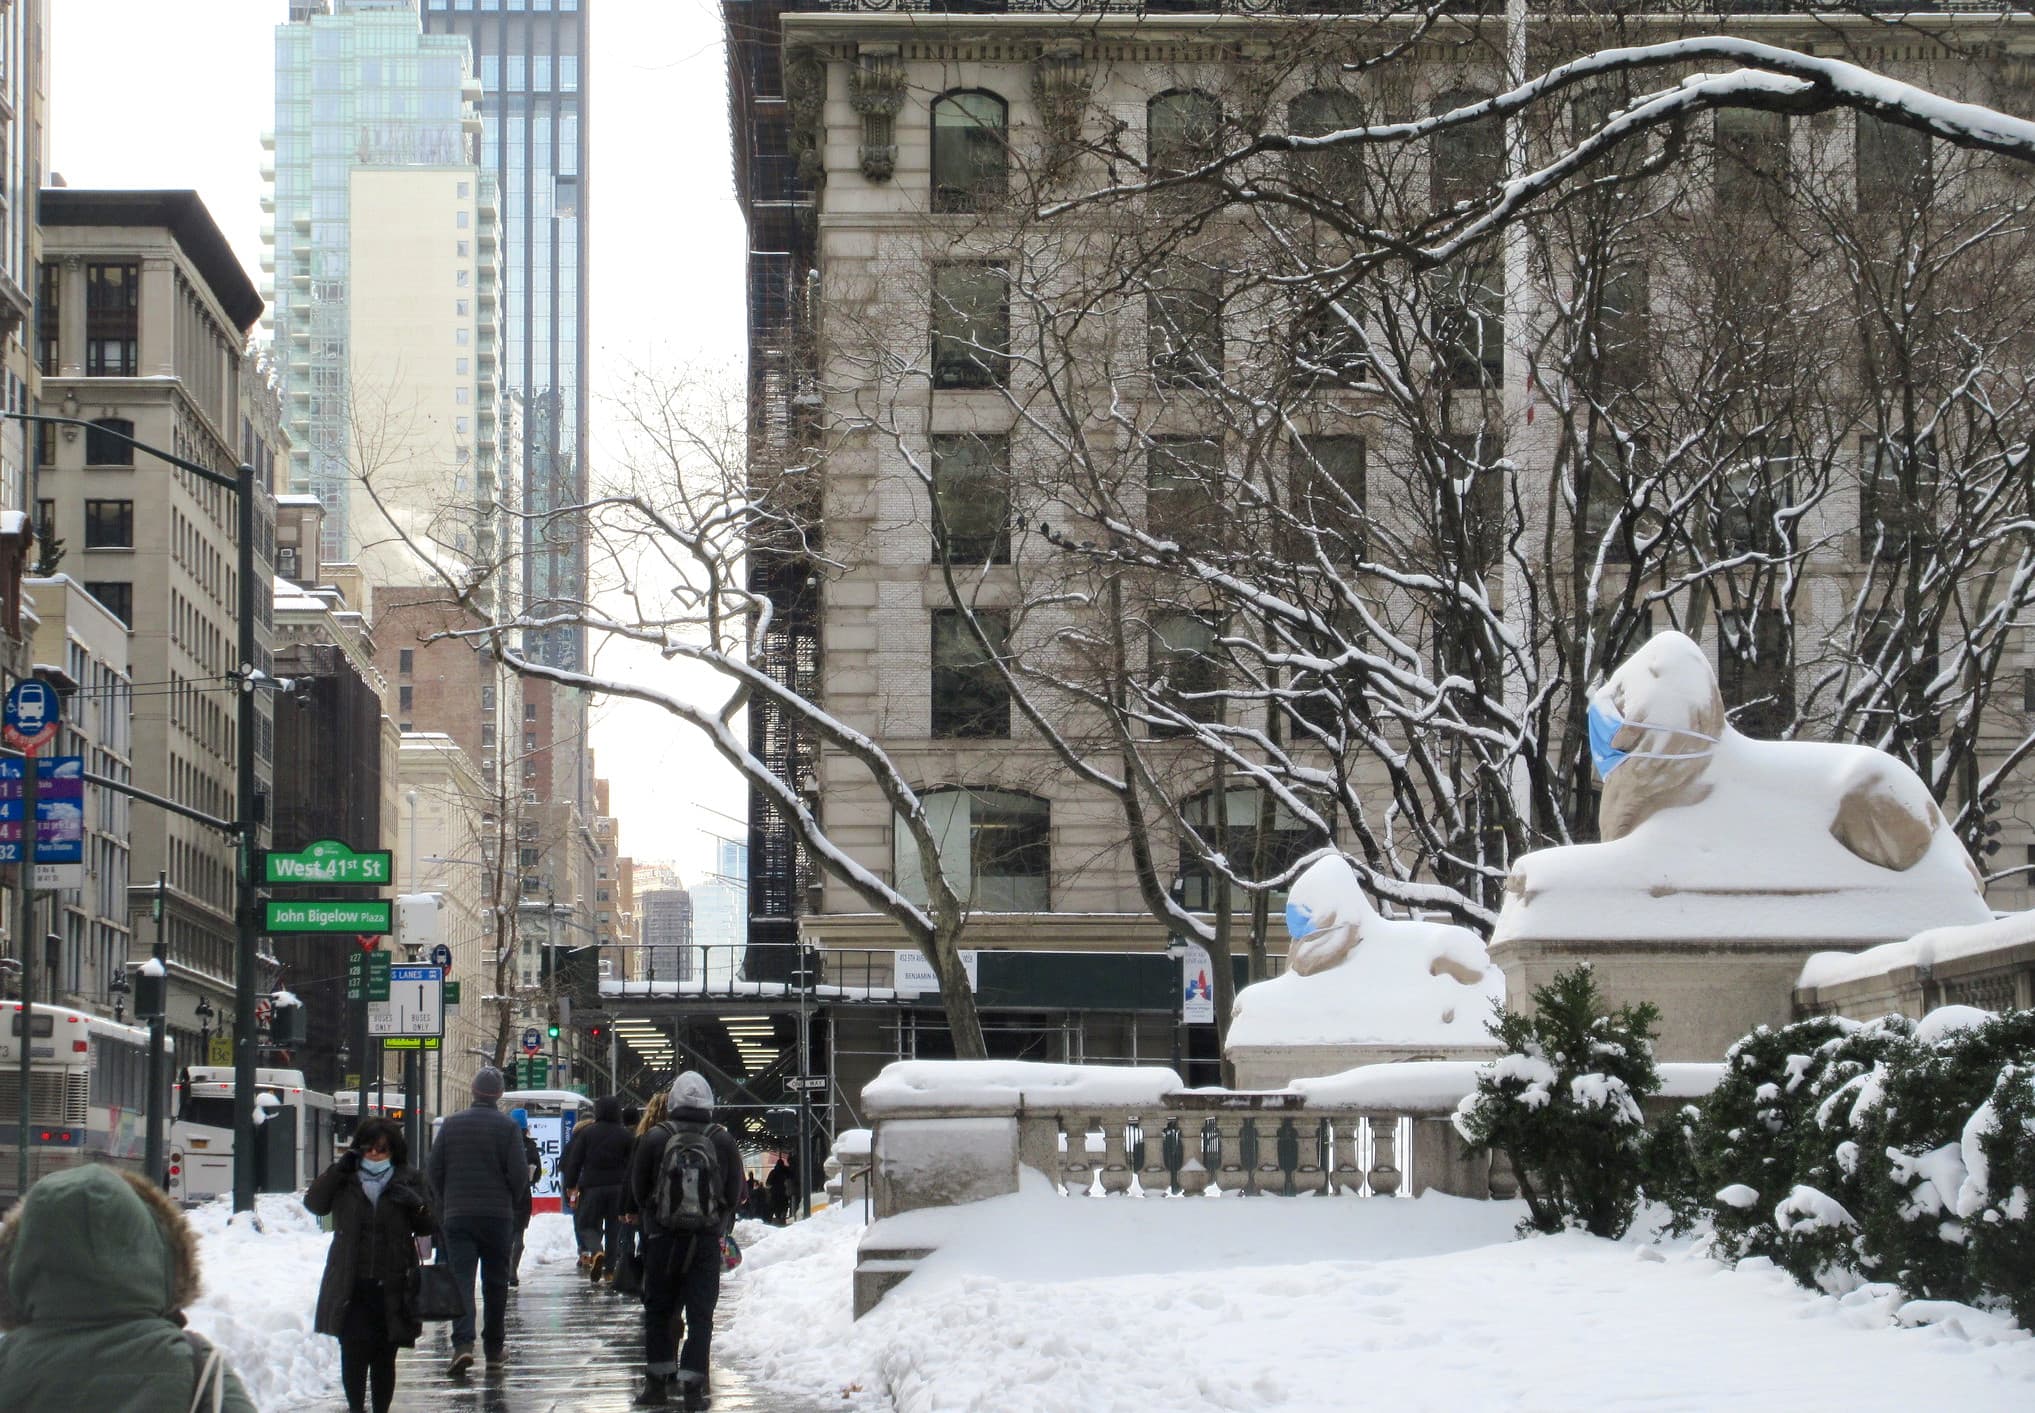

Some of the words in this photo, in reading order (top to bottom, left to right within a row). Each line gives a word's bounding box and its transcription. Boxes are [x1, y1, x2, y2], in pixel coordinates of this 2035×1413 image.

[275, 858, 322, 877] West
[326, 858, 358, 877] 41st
[362, 858, 381, 878] St
[275, 907, 305, 923] John
[308, 907, 359, 926] Bigelow
[361, 911, 385, 923] Plaza
[398, 970, 423, 979] LANES
[411, 1013, 431, 1022] BUSES
[375, 1023, 391, 1032] ONLY
[412, 1023, 429, 1032] ONLY
